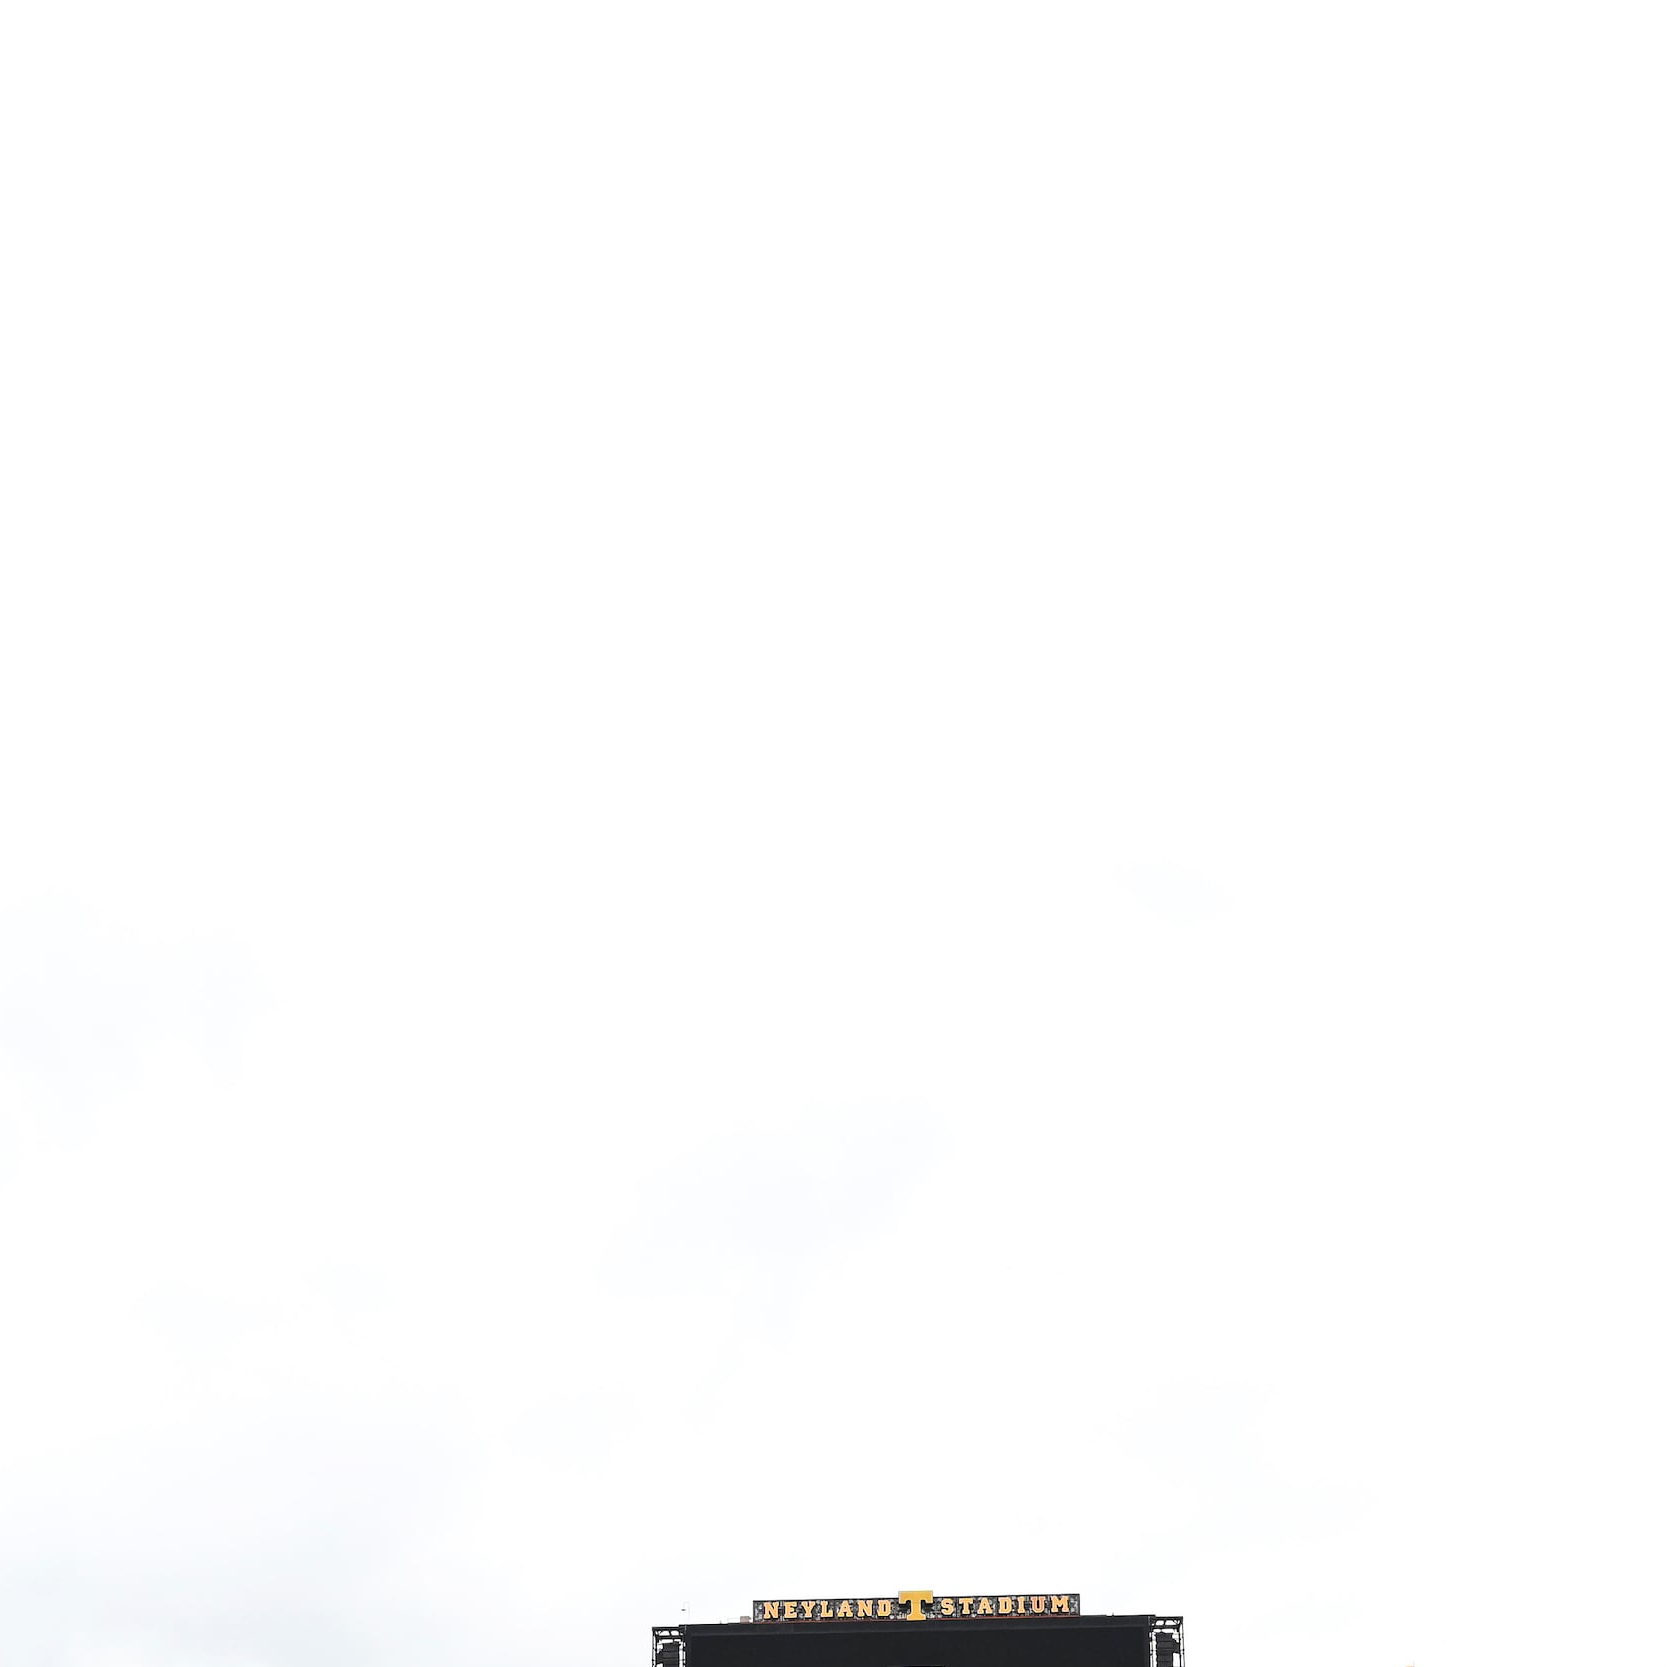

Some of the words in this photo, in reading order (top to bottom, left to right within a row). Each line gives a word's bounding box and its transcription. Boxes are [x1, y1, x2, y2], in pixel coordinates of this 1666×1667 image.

[764, 1600, 892, 1619] NEYLAND
[898, 1590, 933, 1621] T
[941, 1595, 1070, 1615] STADIUM
